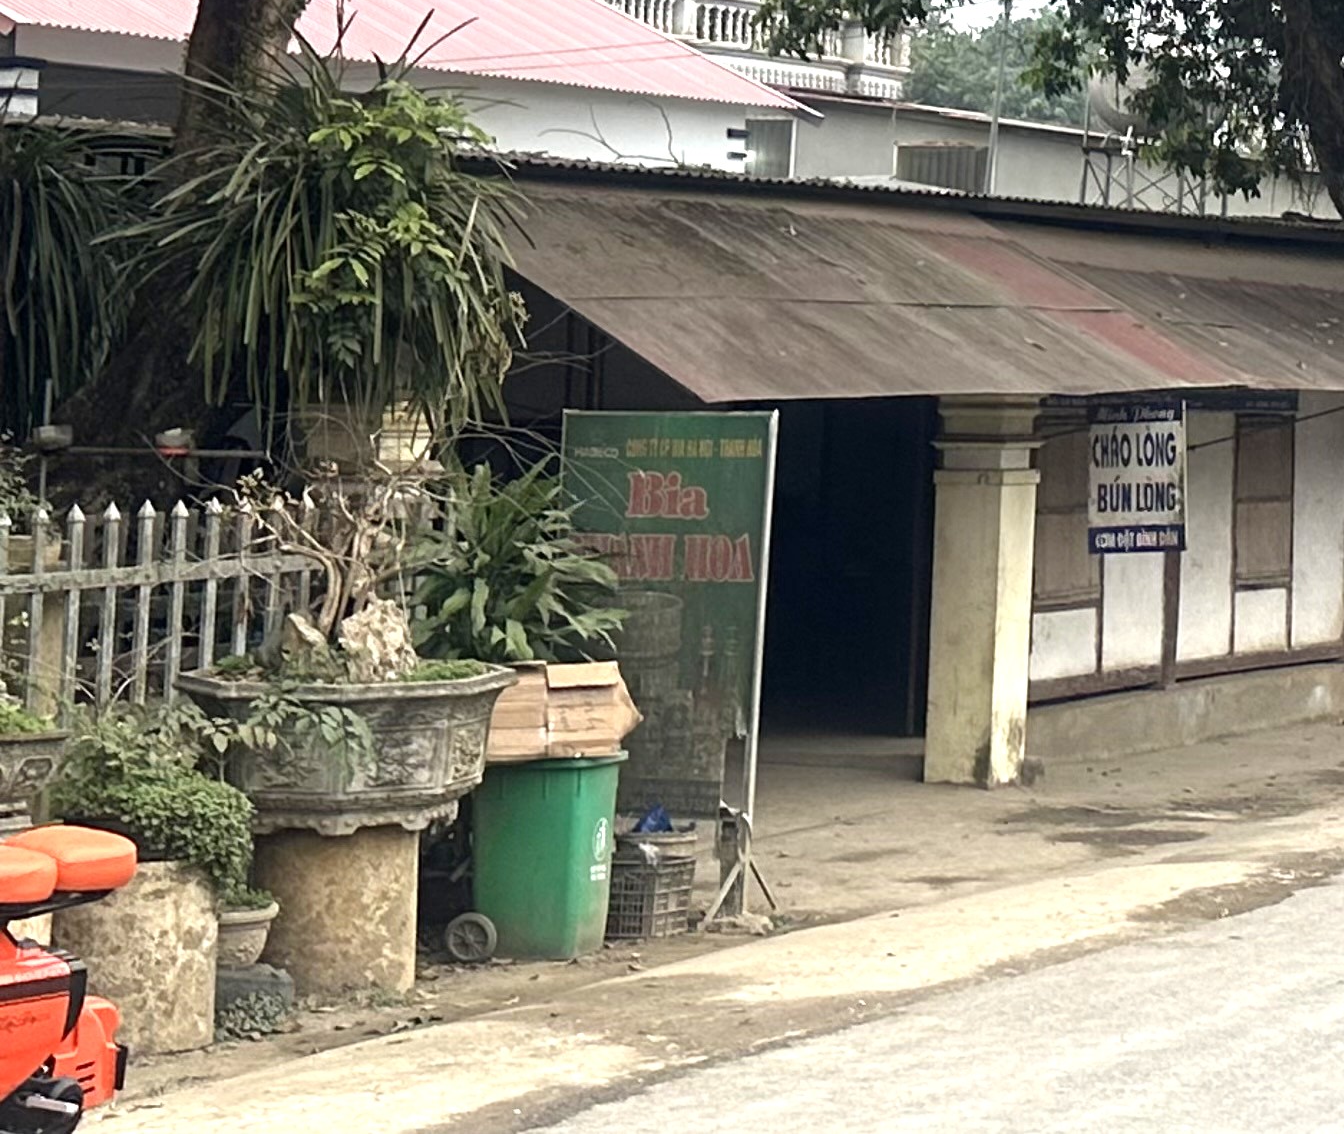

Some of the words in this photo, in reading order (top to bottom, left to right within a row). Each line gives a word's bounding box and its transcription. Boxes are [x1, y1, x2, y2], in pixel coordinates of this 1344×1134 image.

[1092, 425, 1132, 469] CHÁO
[1135, 425, 1177, 468] LÒNG
[625, 471, 710, 520] Bia
[1097, 474, 1132, 513] BÚN
[1135, 475, 1177, 513] LÒNG
